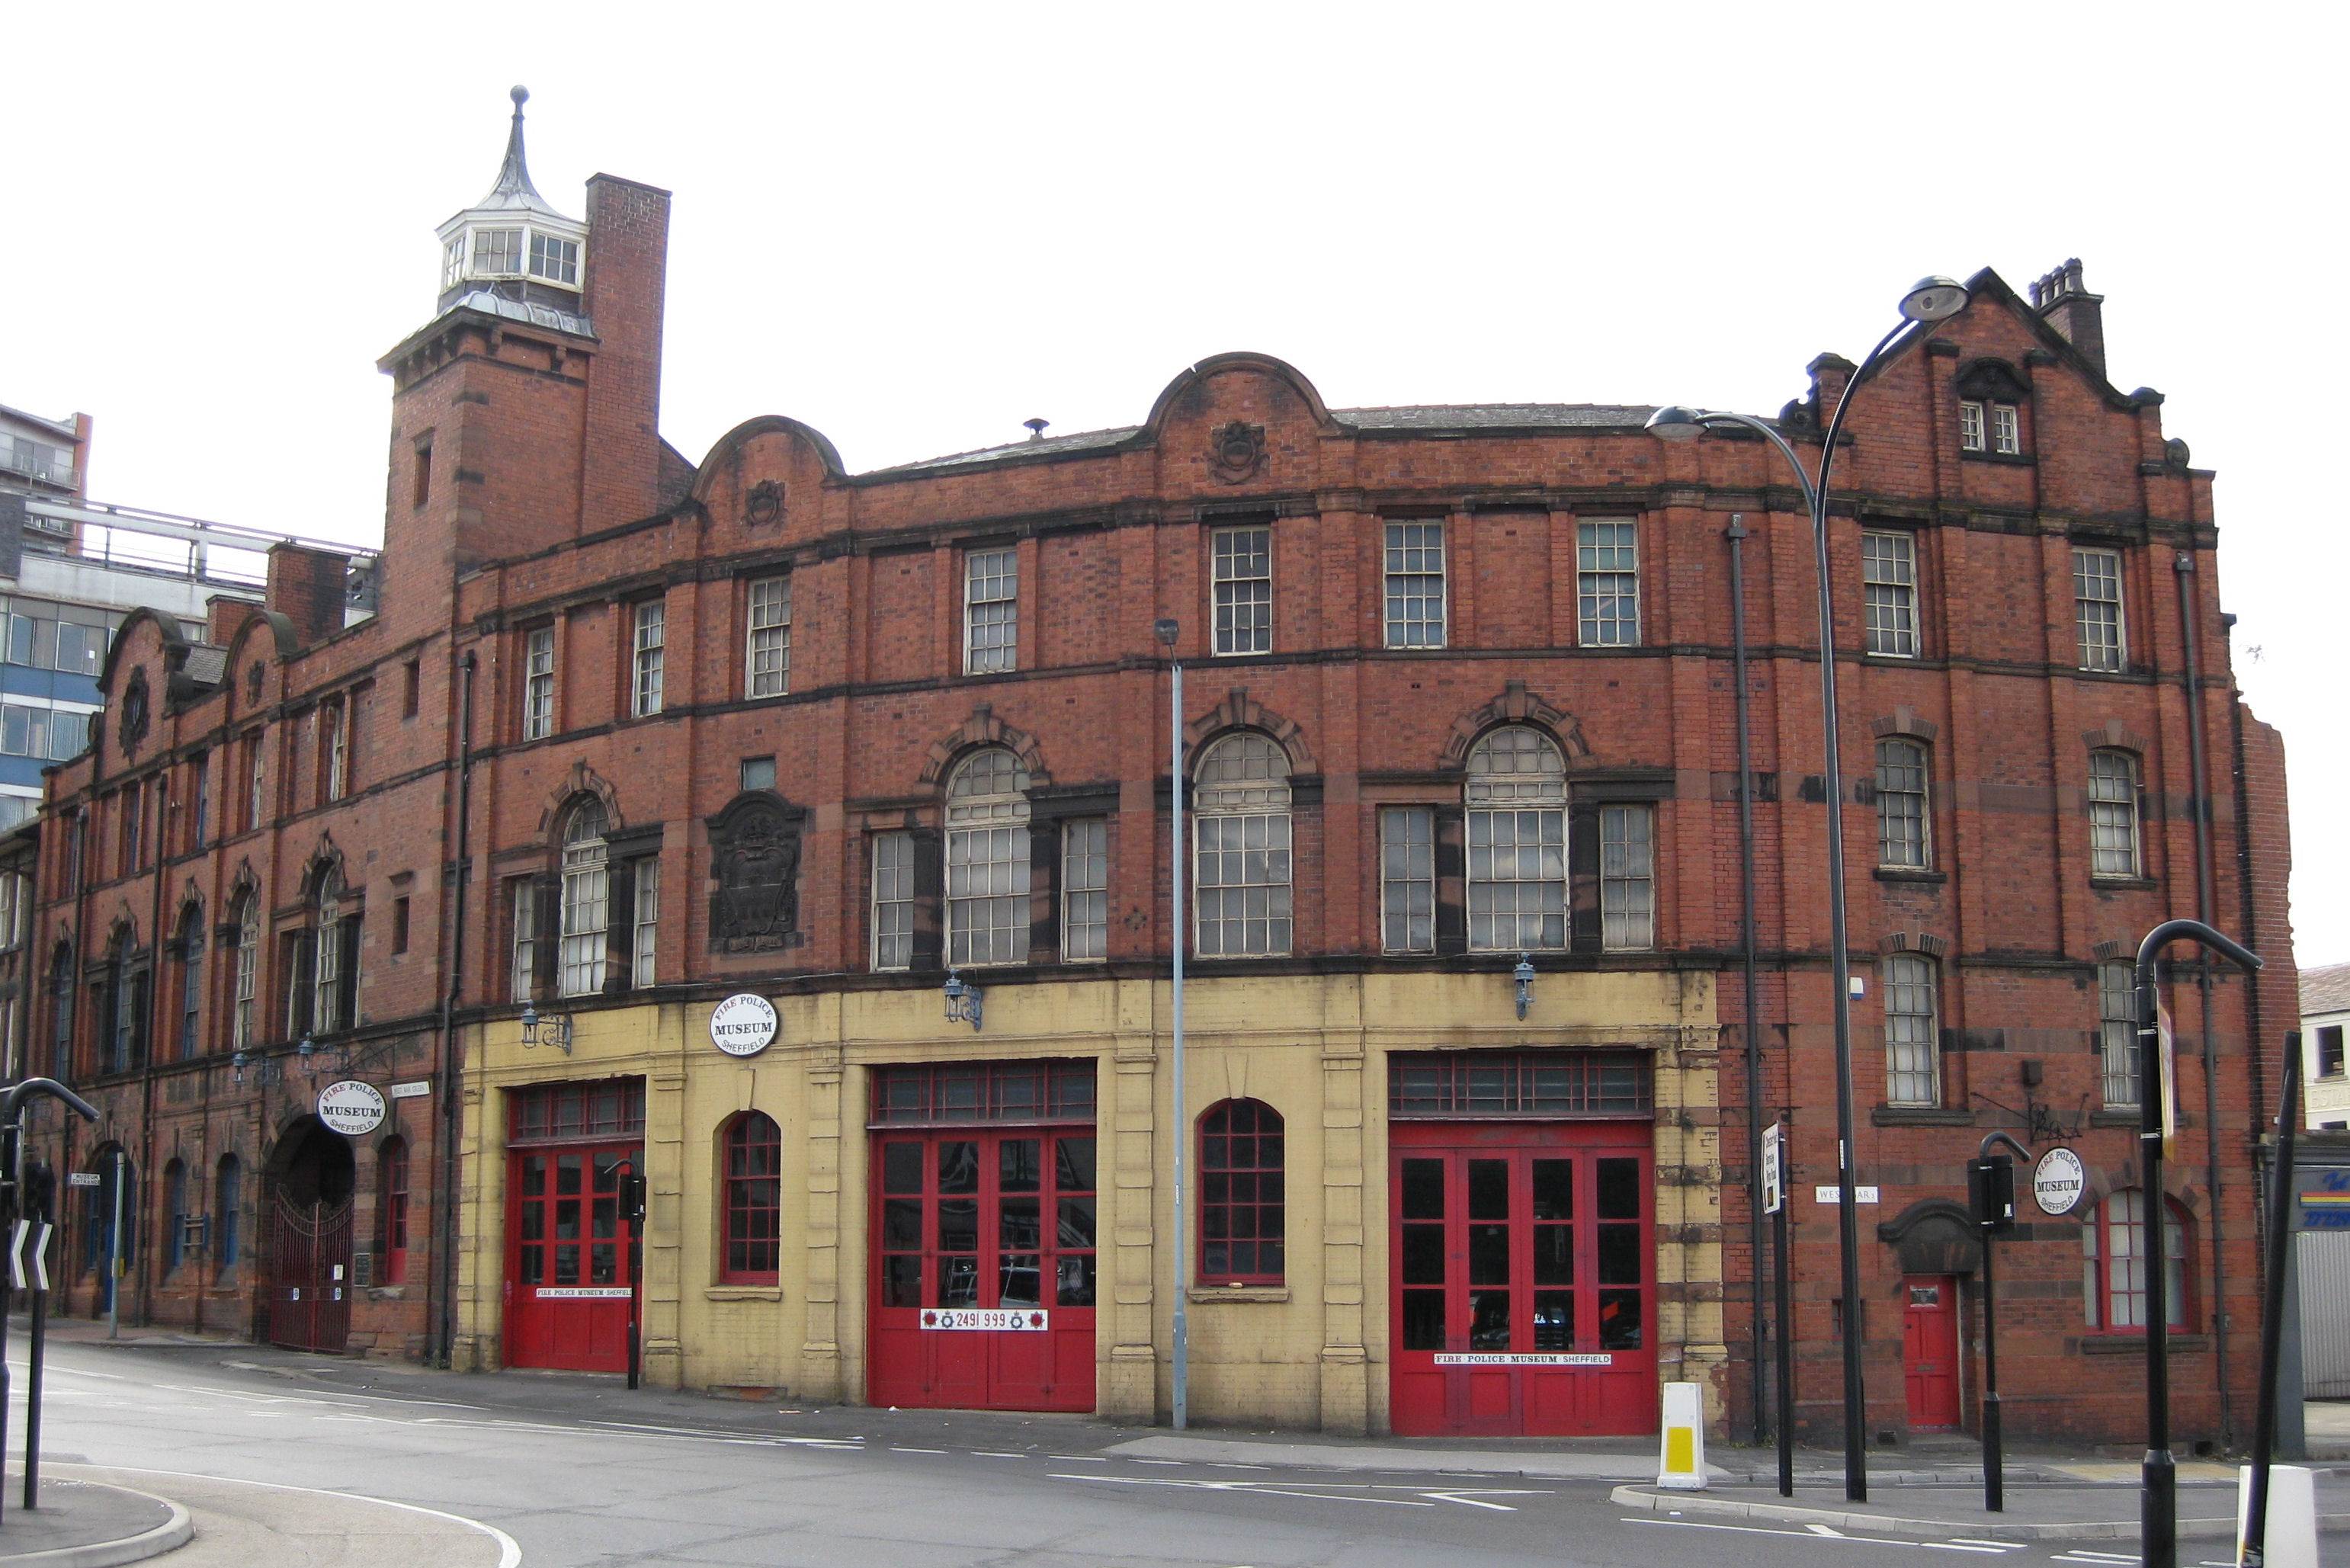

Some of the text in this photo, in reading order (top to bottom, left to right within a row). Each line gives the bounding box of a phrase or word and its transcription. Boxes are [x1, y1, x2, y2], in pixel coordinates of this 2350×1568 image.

[715, 996, 774, 1021] FIRE POLICE
[715, 1022, 773, 1035] MUSEUM
[722, 1037, 765, 1052] SHEFFIELD
[323, 1082, 383, 1105] FIRE POLICE
[322, 1105, 382, 1117] MUSEUM
[330, 1119, 374, 1133] SHEFFIELD
[2037, 1151, 2081, 1177] FIRE POLICE
[2036, 1179, 2080, 1192] MUSEUM
[1819, 1190, 1840, 1198] WES
[1857, 1190, 1869, 1198] AR
[2041, 1195, 2074, 1210] SHEFFIELD
[957, 1313, 1005, 1327] 2491 999
